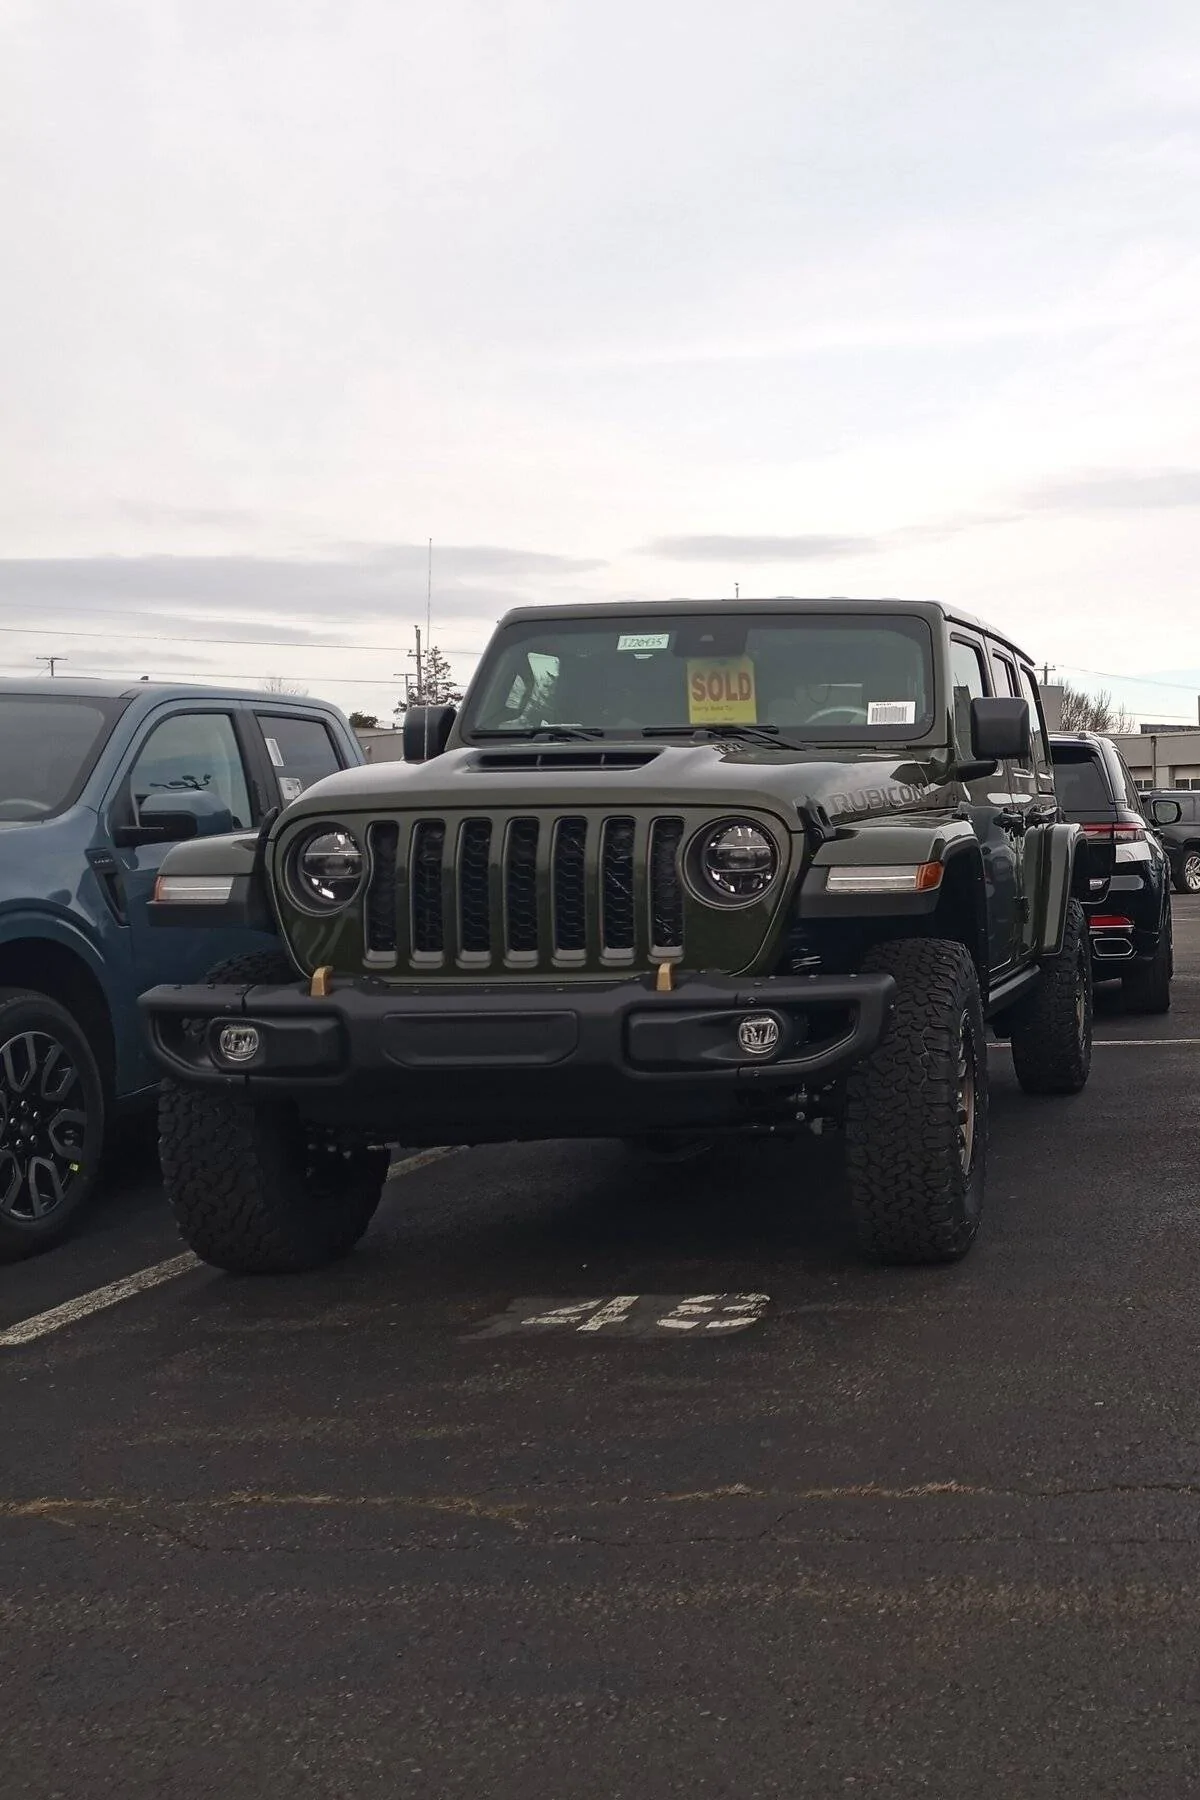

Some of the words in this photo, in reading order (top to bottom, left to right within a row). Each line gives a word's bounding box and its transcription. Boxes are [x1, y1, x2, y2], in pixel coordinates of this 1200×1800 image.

[691, 671, 752, 701] SOLD
[831, 783, 925, 814] RUBICON
[520, 1294, 770, 1332] 48
